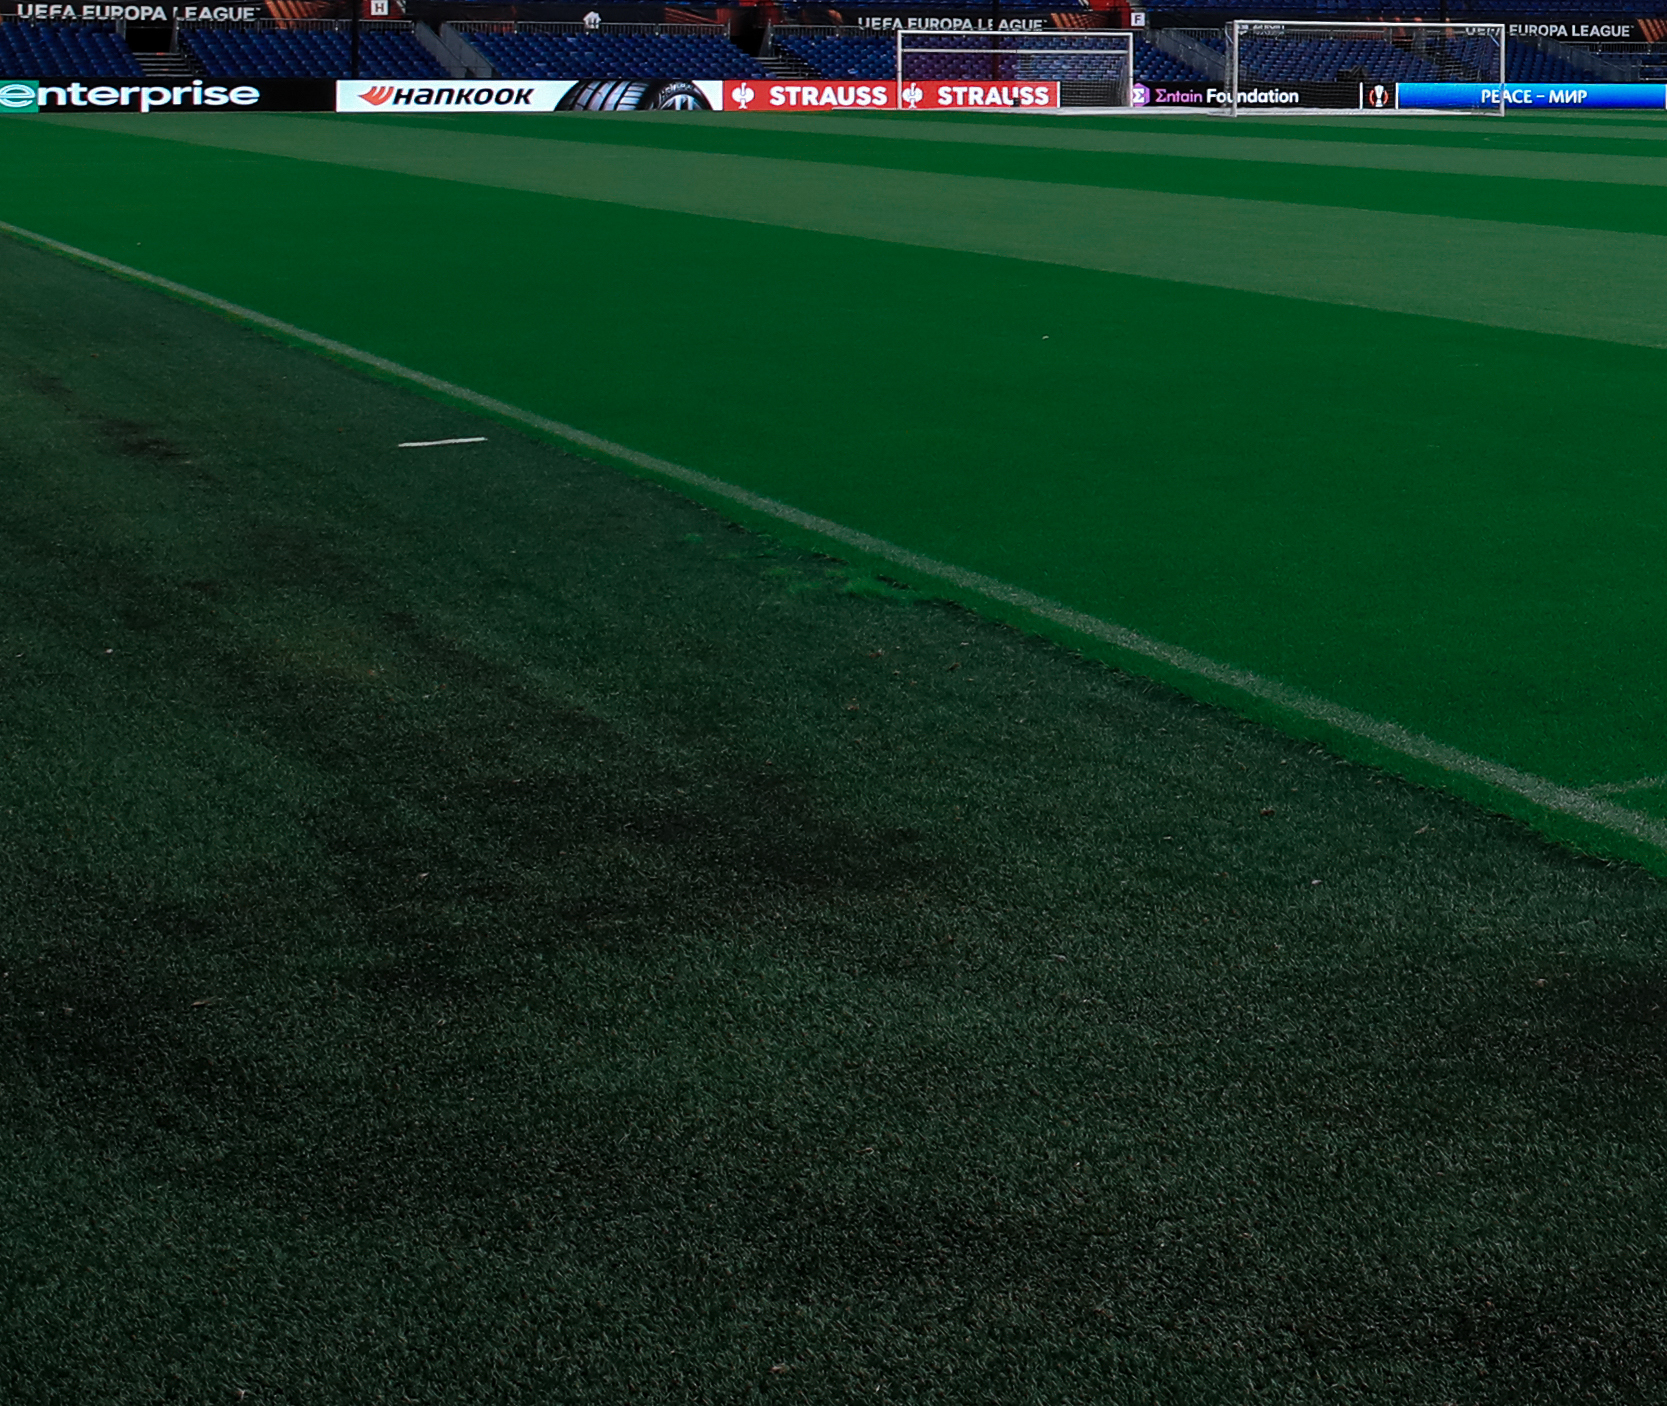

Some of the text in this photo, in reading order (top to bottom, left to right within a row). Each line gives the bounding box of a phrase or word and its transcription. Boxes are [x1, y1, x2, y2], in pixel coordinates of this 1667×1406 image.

[17, 2, 256, 22] UEFA EUROPA LEAGUE
[858, 15, 902, 28] UEFA
[908, 16, 972, 29] EUROPA
[1509, 23, 1567, 36] EUROPA
[1572, 23, 1630, 36] LEAGUE
[0, 78, 260, 112] enterprise
[769, 85, 888, 105] STRAUSS
[937, 85, 1049, 105] STRAUSS
[1481, 88, 1532, 103] PEACE
